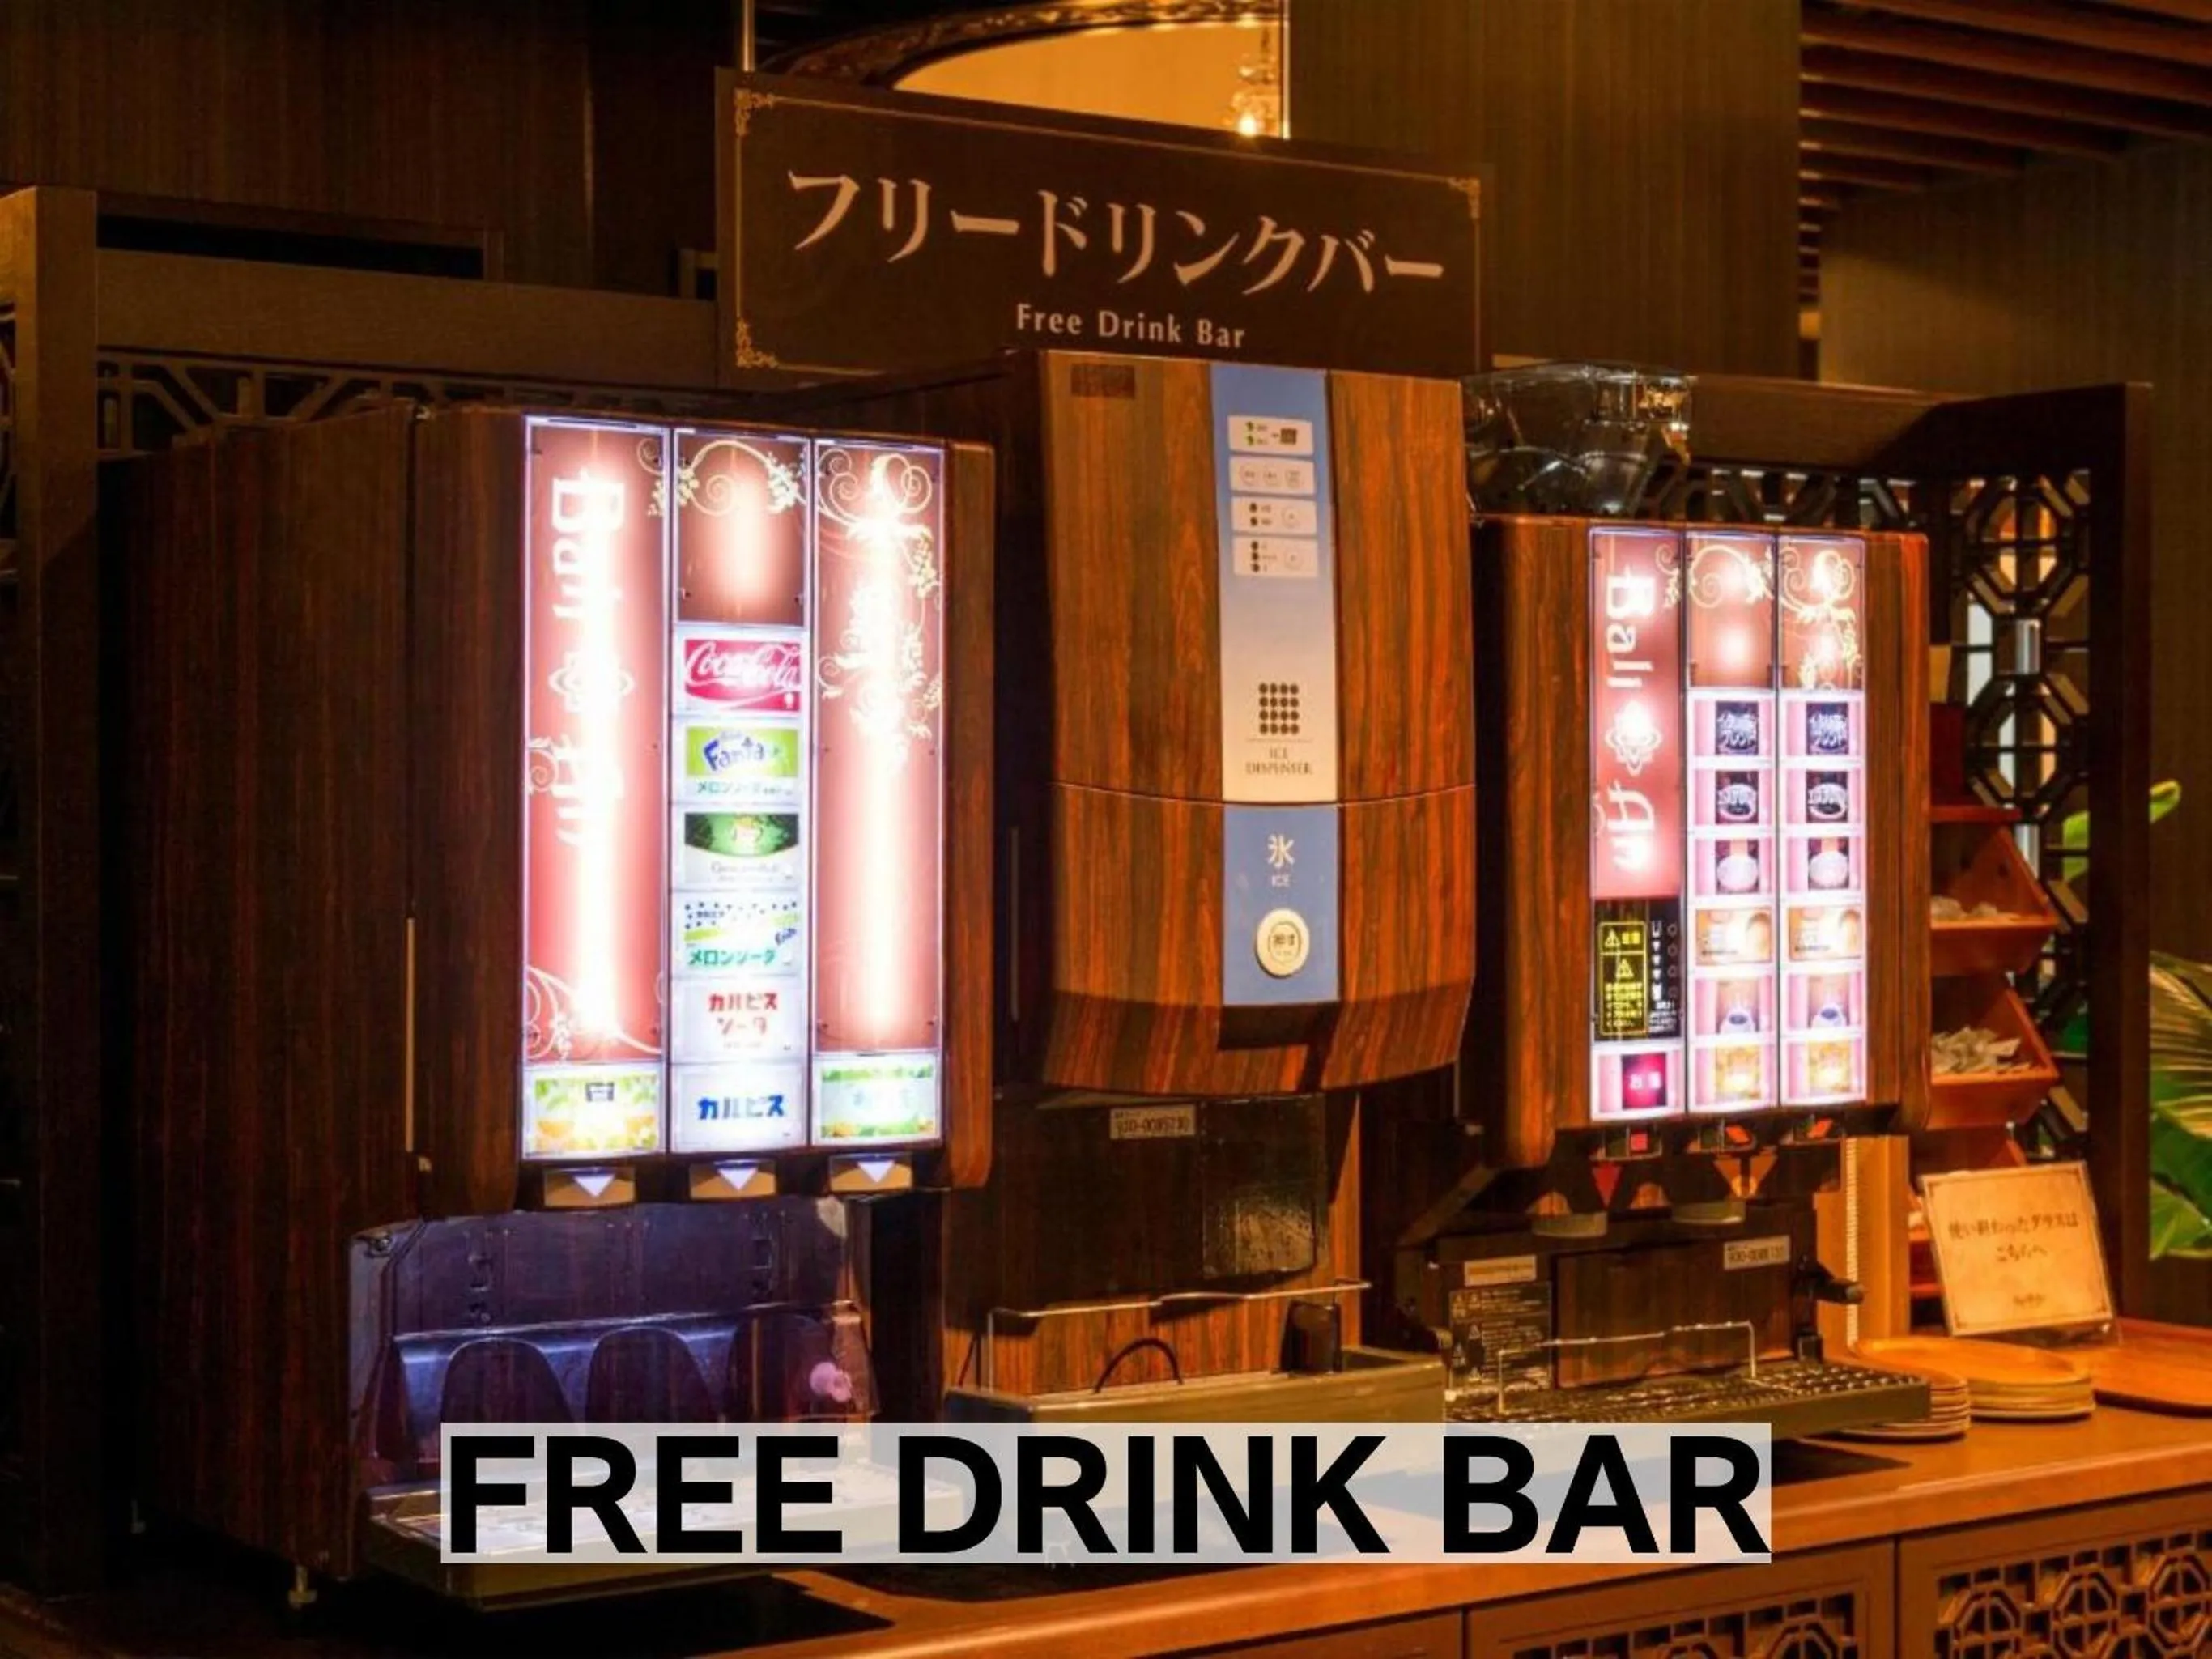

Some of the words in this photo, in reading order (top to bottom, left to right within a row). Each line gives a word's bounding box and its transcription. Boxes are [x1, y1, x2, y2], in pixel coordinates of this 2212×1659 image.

[788, 169, 1444, 296] フリードリンクバー
[1016, 303, 1083, 337] Free
[1098, 310, 1182, 345] Drink
[1197, 319, 1246, 348] Bar
[702, 736, 766, 772] Fanta
[1267, 833, 1295, 868] 氷
[1270, 874, 1291, 888] ICE
